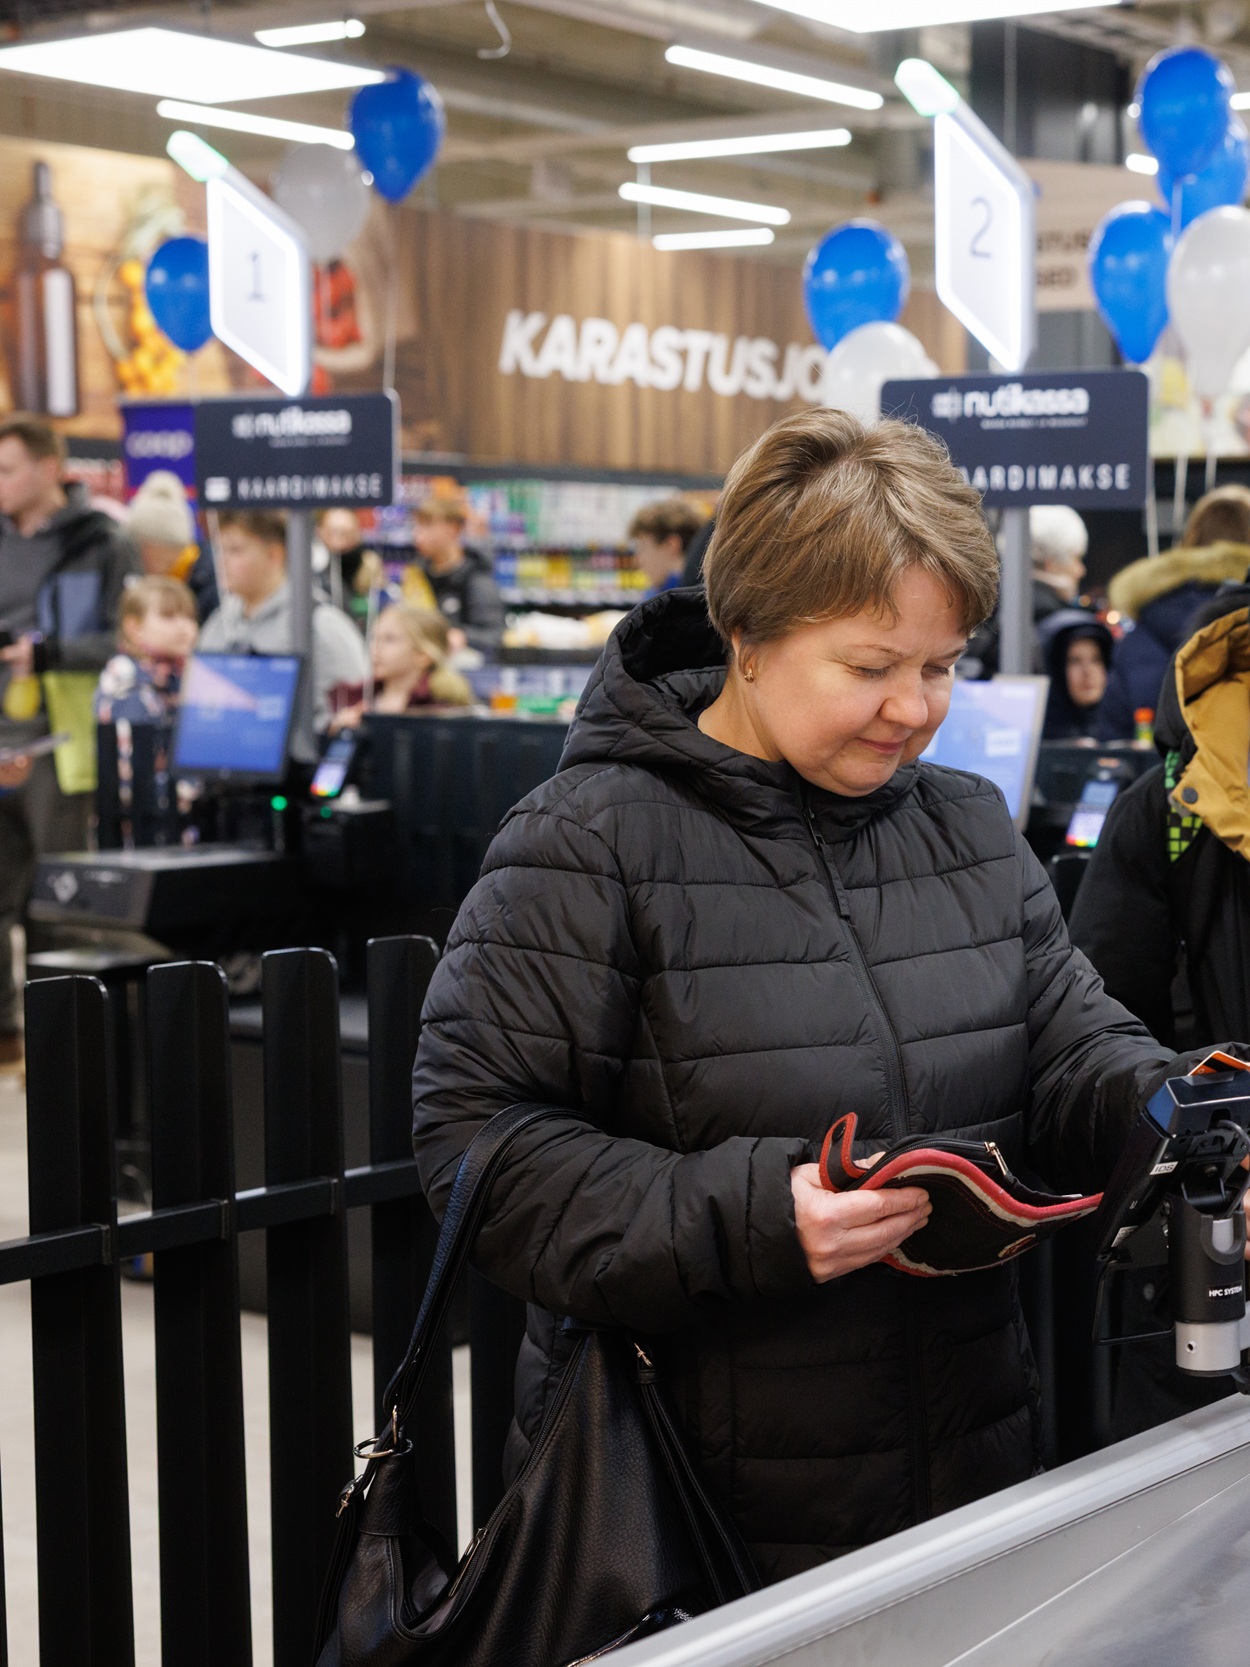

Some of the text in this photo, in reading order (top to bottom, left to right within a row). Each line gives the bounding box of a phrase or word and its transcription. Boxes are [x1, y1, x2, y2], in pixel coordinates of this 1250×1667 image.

[969, 196, 994, 259] 2
[248, 252, 266, 302] 1
[500, 309, 829, 402] KARASTUSJO
